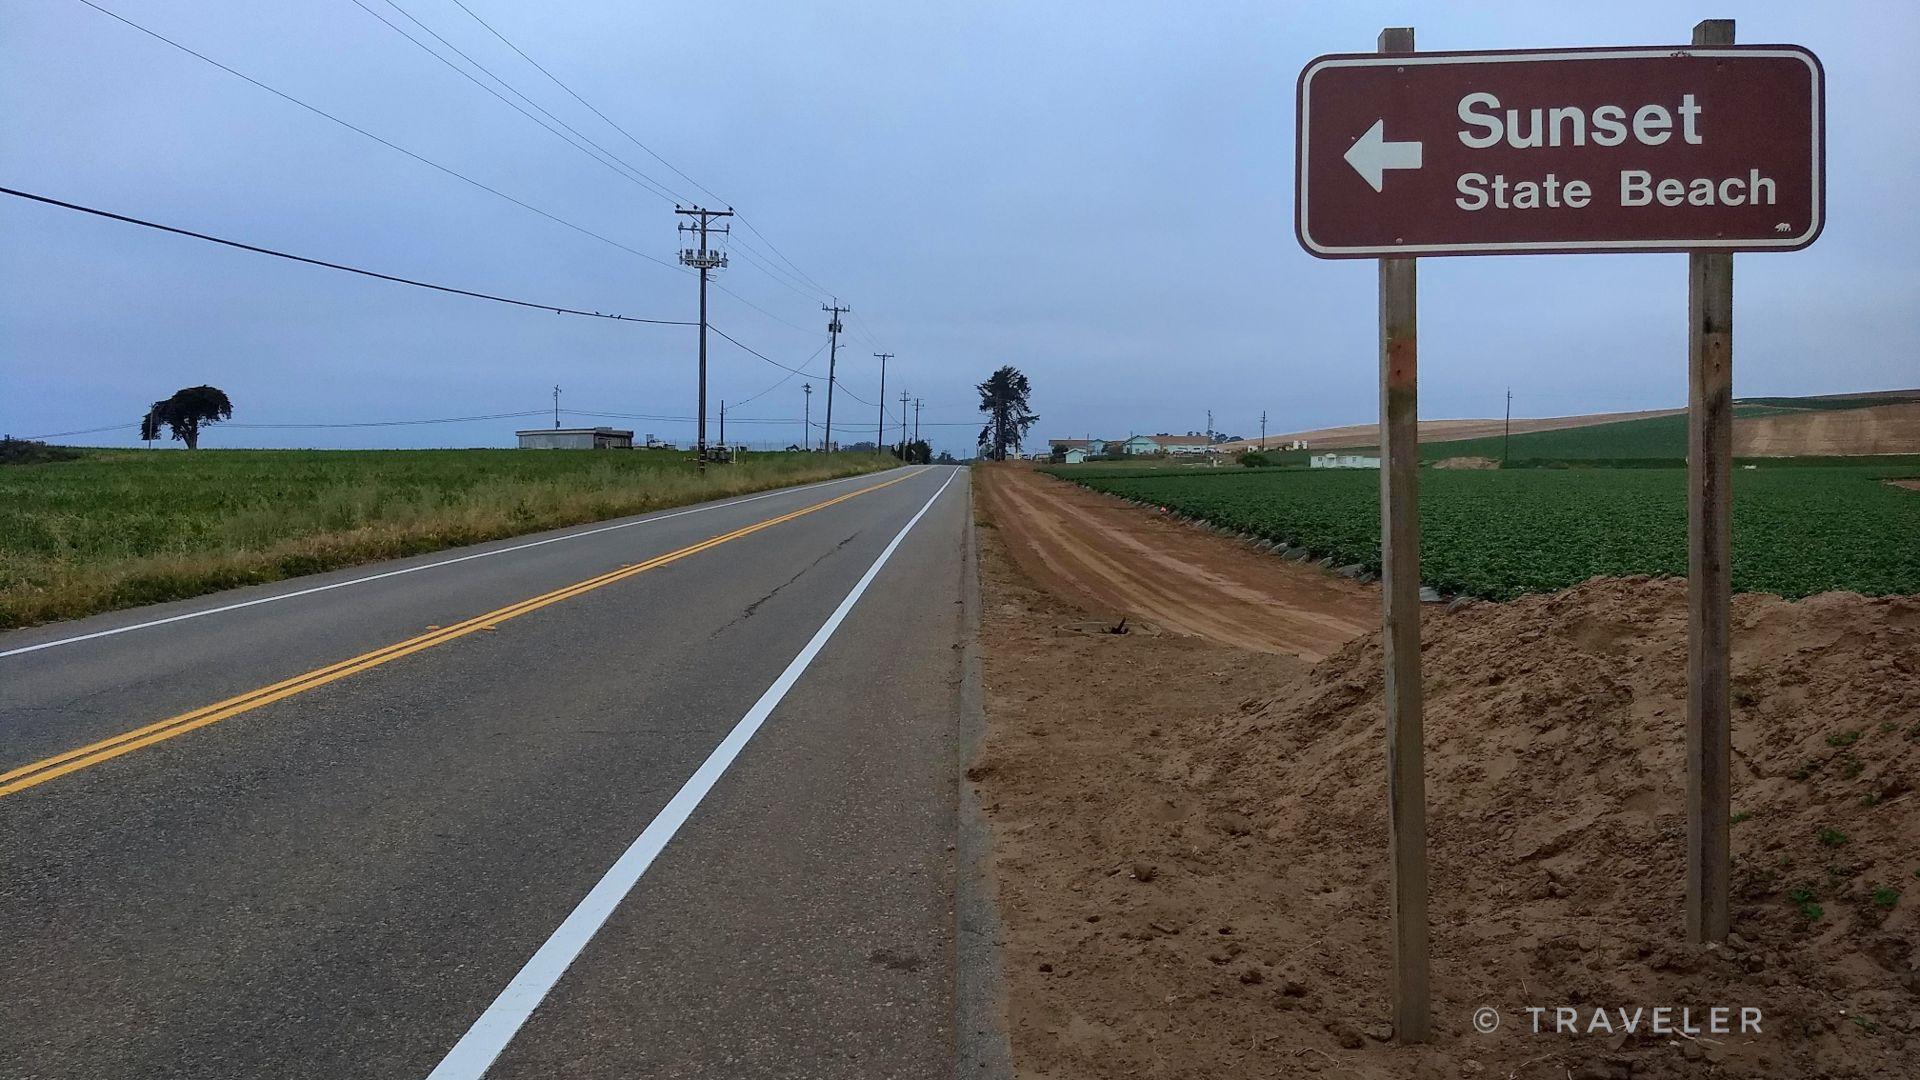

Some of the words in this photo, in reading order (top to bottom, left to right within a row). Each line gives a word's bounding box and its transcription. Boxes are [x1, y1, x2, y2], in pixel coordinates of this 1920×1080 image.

[1457, 92, 1703, 149] Sunset
[1455, 172, 1592, 211] State
[1620, 168, 1776, 207] Beach
